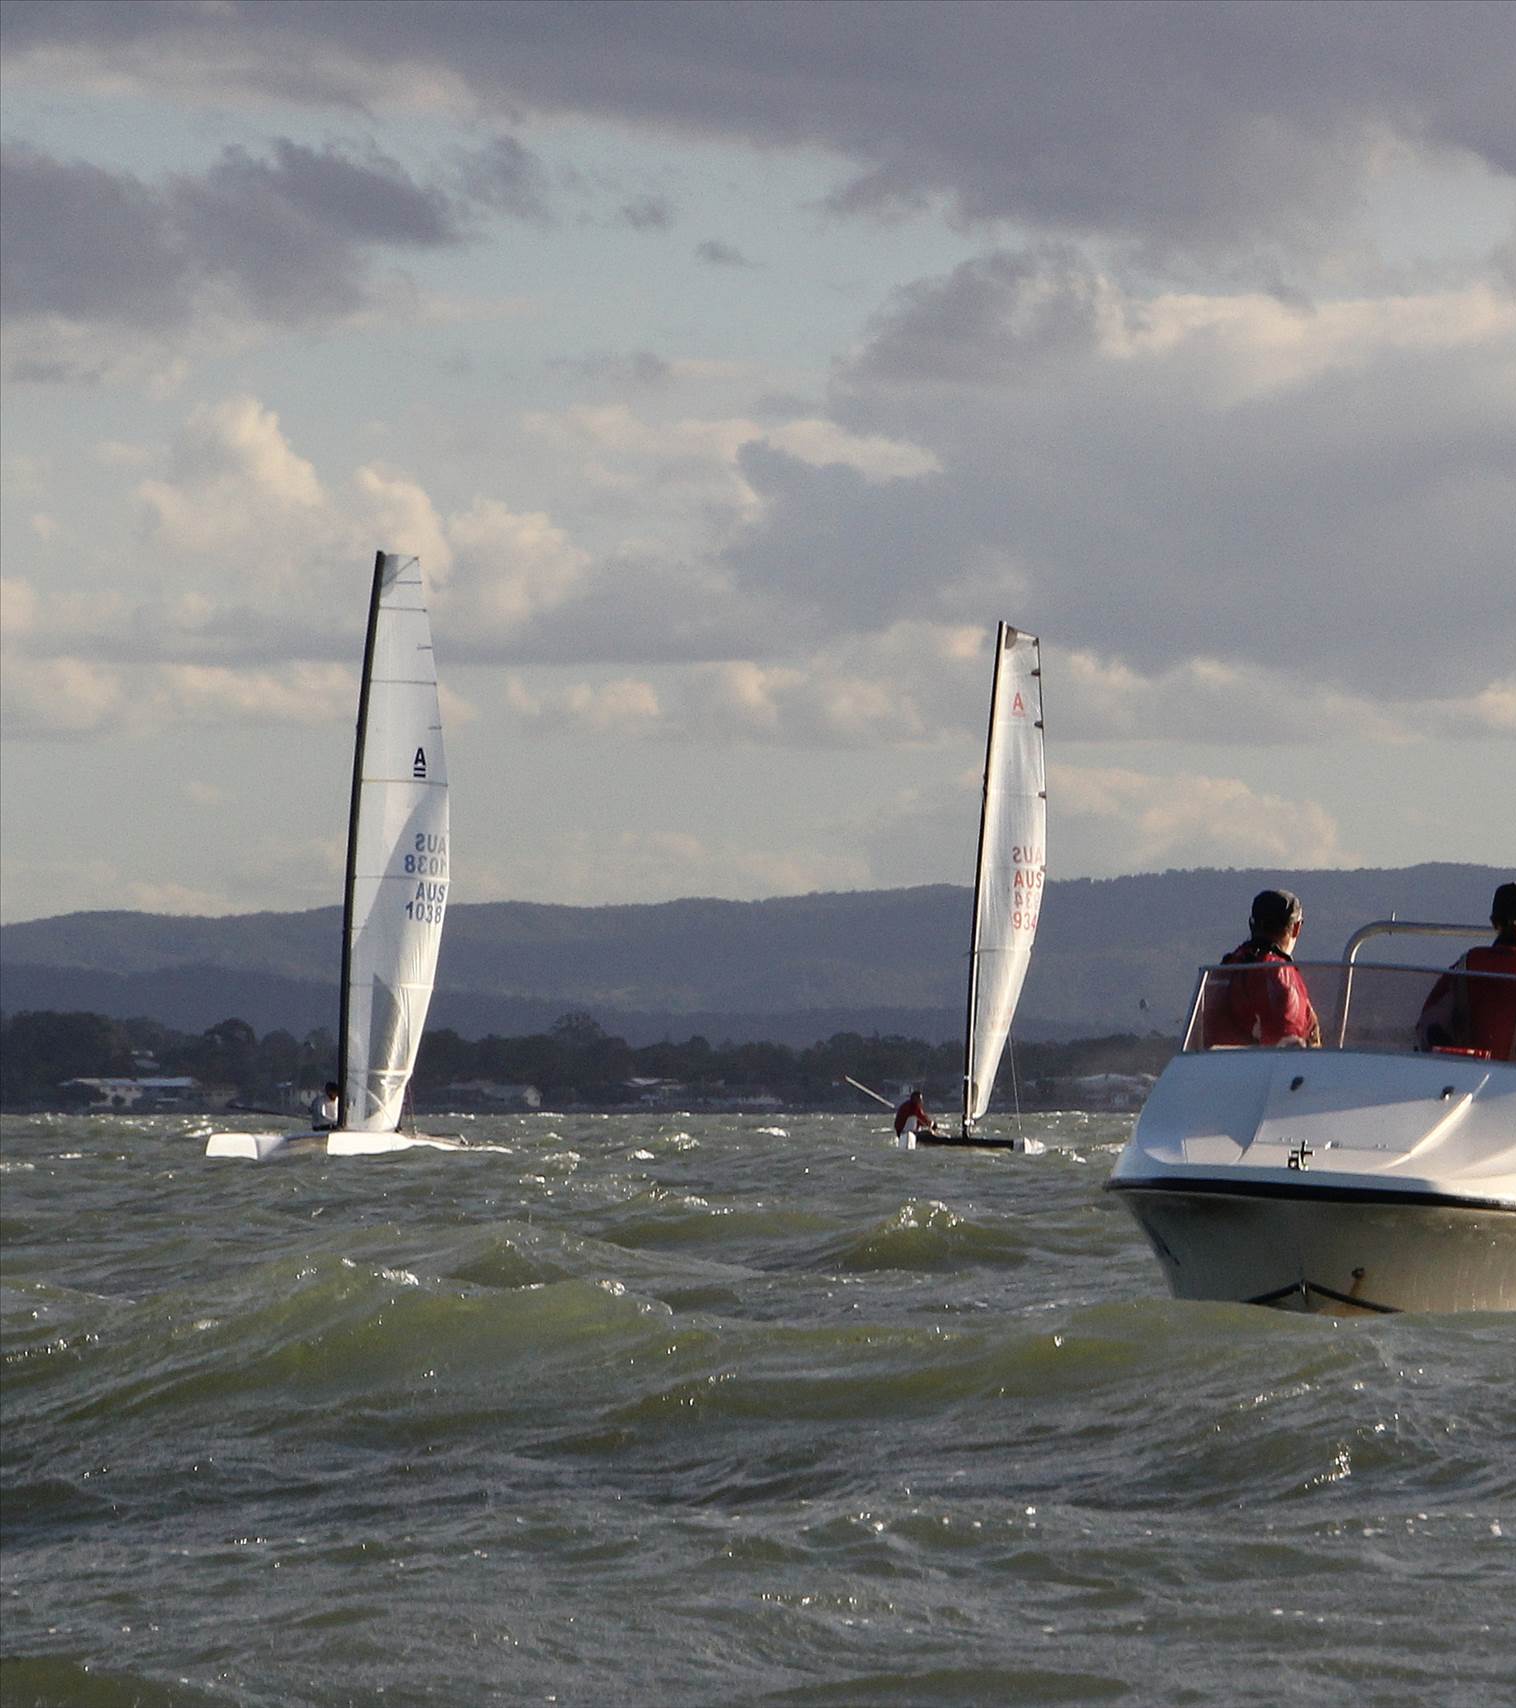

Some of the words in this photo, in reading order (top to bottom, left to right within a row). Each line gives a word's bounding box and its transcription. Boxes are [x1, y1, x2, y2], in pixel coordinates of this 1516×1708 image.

[1012, 692, 1024, 711] A
[414, 748, 426, 765] A
[1014, 870, 1042, 889] AUS
[415, 882, 446, 903] AUS
[405, 901, 442, 924] 1038
